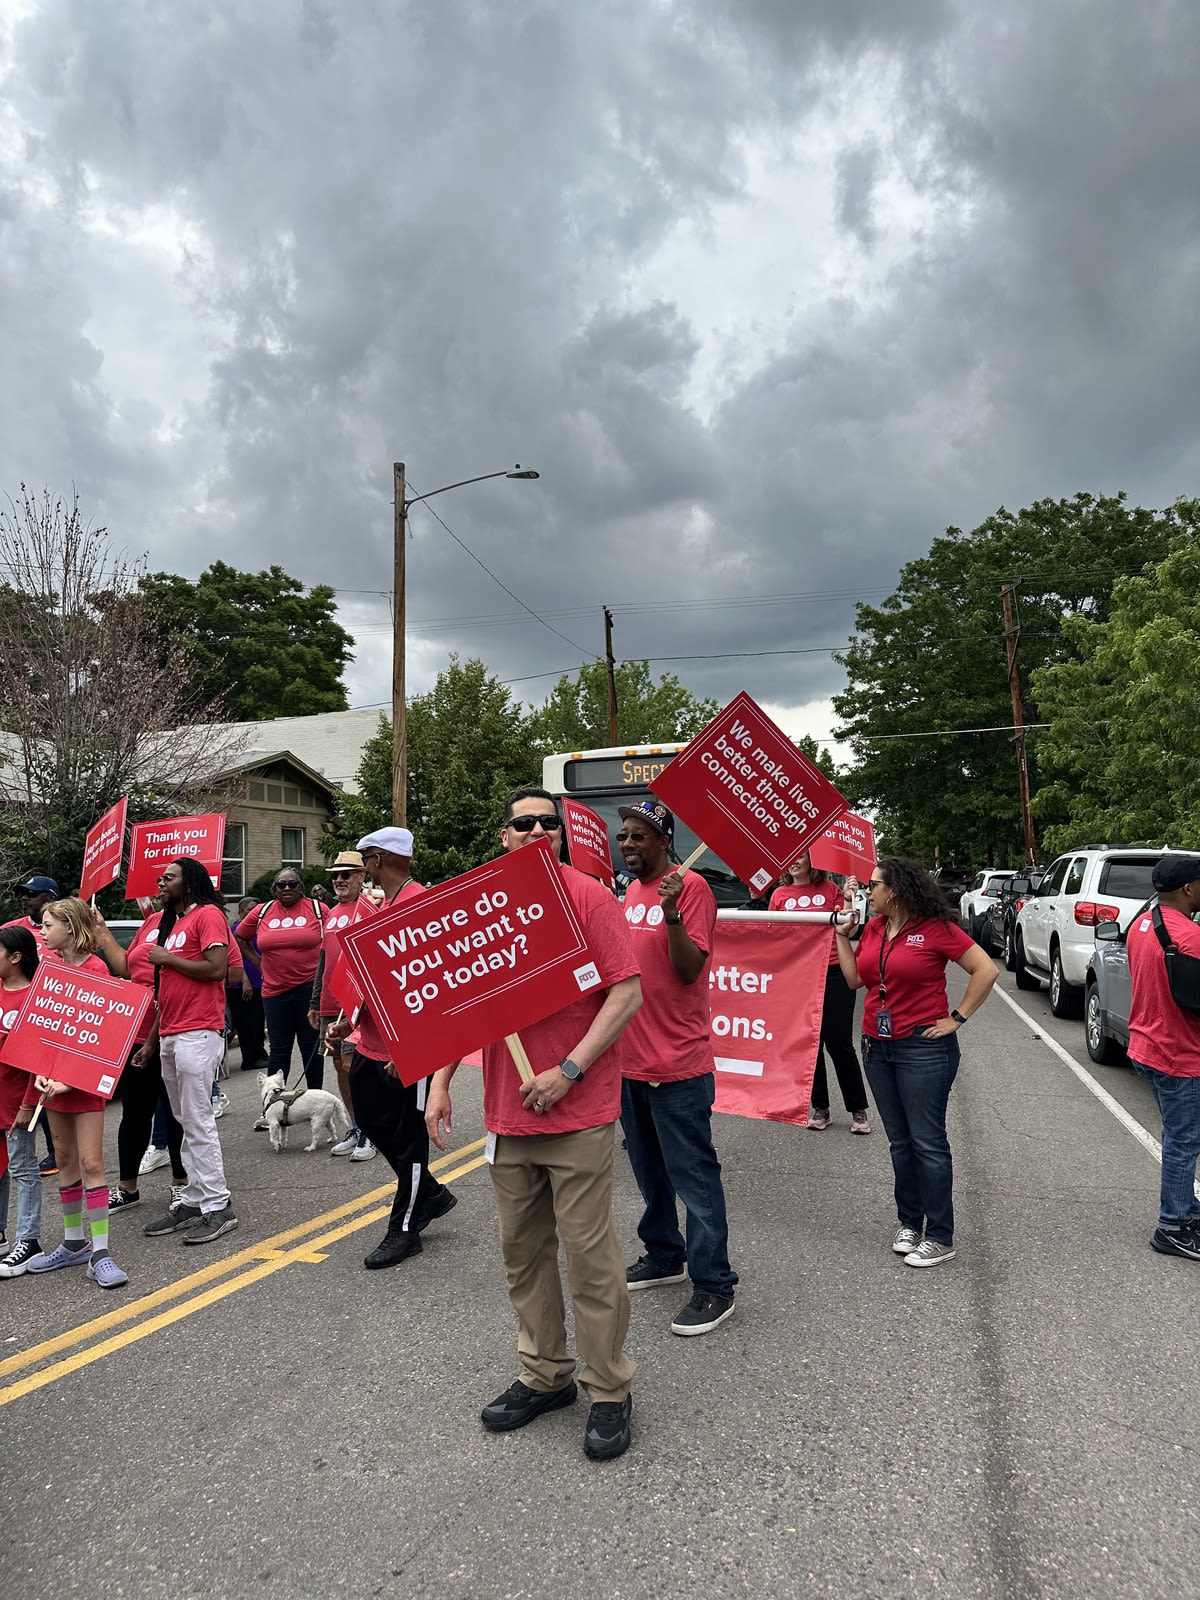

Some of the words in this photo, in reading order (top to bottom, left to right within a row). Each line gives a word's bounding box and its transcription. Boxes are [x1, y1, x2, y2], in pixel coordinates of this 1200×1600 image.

[730, 719, 753, 749] We
[751, 747, 790, 787] make
[788, 783, 819, 819] lives
[700, 752, 780, 837] connections.
[714, 734, 758, 780] better
[756, 778, 808, 834] through
[569, 810, 588, 824] We'll
[571, 823, 595, 838] where
[833, 819, 850, 831] ank
[850, 824, 866, 838] you
[146, 829, 181, 844] Thank
[184, 828, 208, 842] you
[573, 834, 593, 848] need
[838, 831, 865, 852] riding.
[144, 848, 159, 859] for
[162, 845, 201, 857] riding.
[377, 909, 469, 959] Where
[474, 890, 509, 917] do
[390, 949, 444, 990] you
[446, 914, 515, 957] want
[516, 903, 545, 926] to
[404, 982, 439, 1014] go
[442, 933, 529, 989] today?
[578, 970, 596, 984] RTD
[709, 966, 773, 994] tter
[43, 976, 75, 998] We'll
[76, 988, 105, 1007] take
[106, 1000, 135, 1017] you
[35, 996, 75, 1017] where
[75, 1009, 104, 1027] you
[27, 1012, 62, 1032] need
[62, 1022, 77, 1037] to
[77, 1029, 100, 1045] go.
[710, 1015, 773, 1041] ons.
